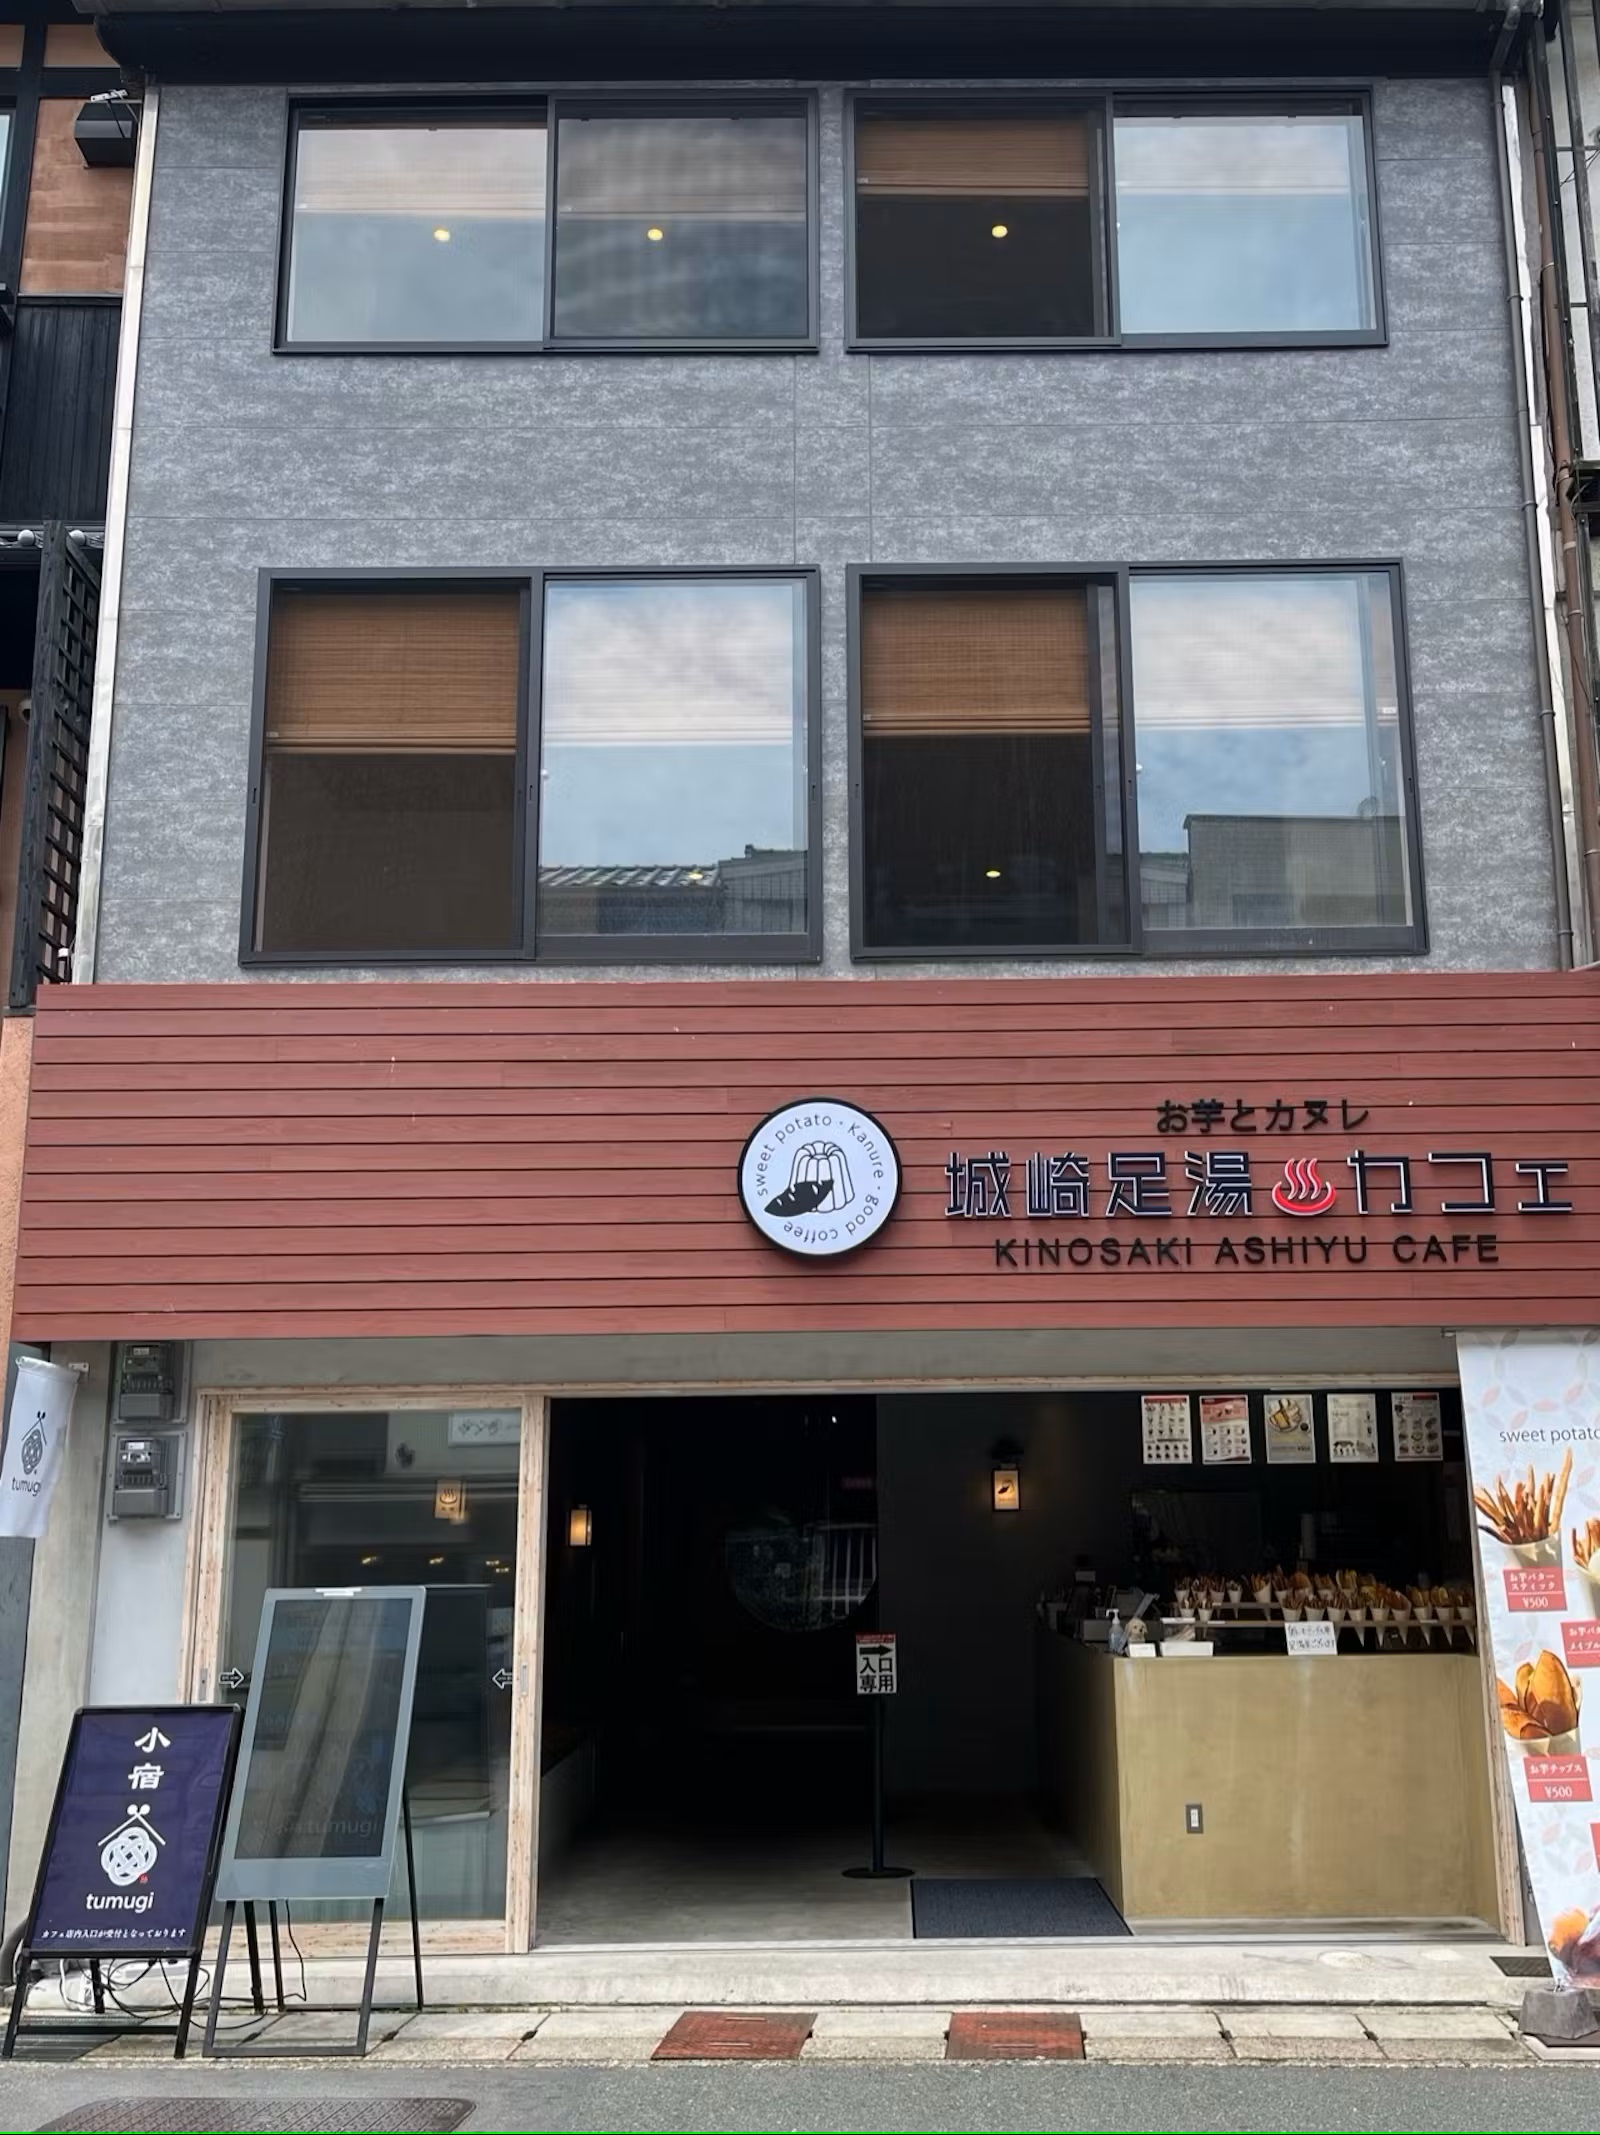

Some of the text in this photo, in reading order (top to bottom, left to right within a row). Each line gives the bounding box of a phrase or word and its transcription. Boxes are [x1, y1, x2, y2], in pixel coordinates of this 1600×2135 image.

[1157, 1099, 1369, 1132] お芋とカヌレ
[756, 1114, 884, 1243] sweet potato Kanure good coffee
[945, 1150, 1253, 1217] 城崎足湯
[995, 1235, 1499, 1267] KINOSAKI ASHIYU CAFE
[1499, 1429, 1546, 1442] sweet
[1522, 1596, 1548, 1608] ¥500
[860, 1657, 893, 1674] 入口
[859, 1674, 894, 1692] 専用
[128, 1727, 170, 1789] 小宿
[1544, 1786, 1573, 1798] ¥500
[86, 1892, 154, 1913] tumugi
